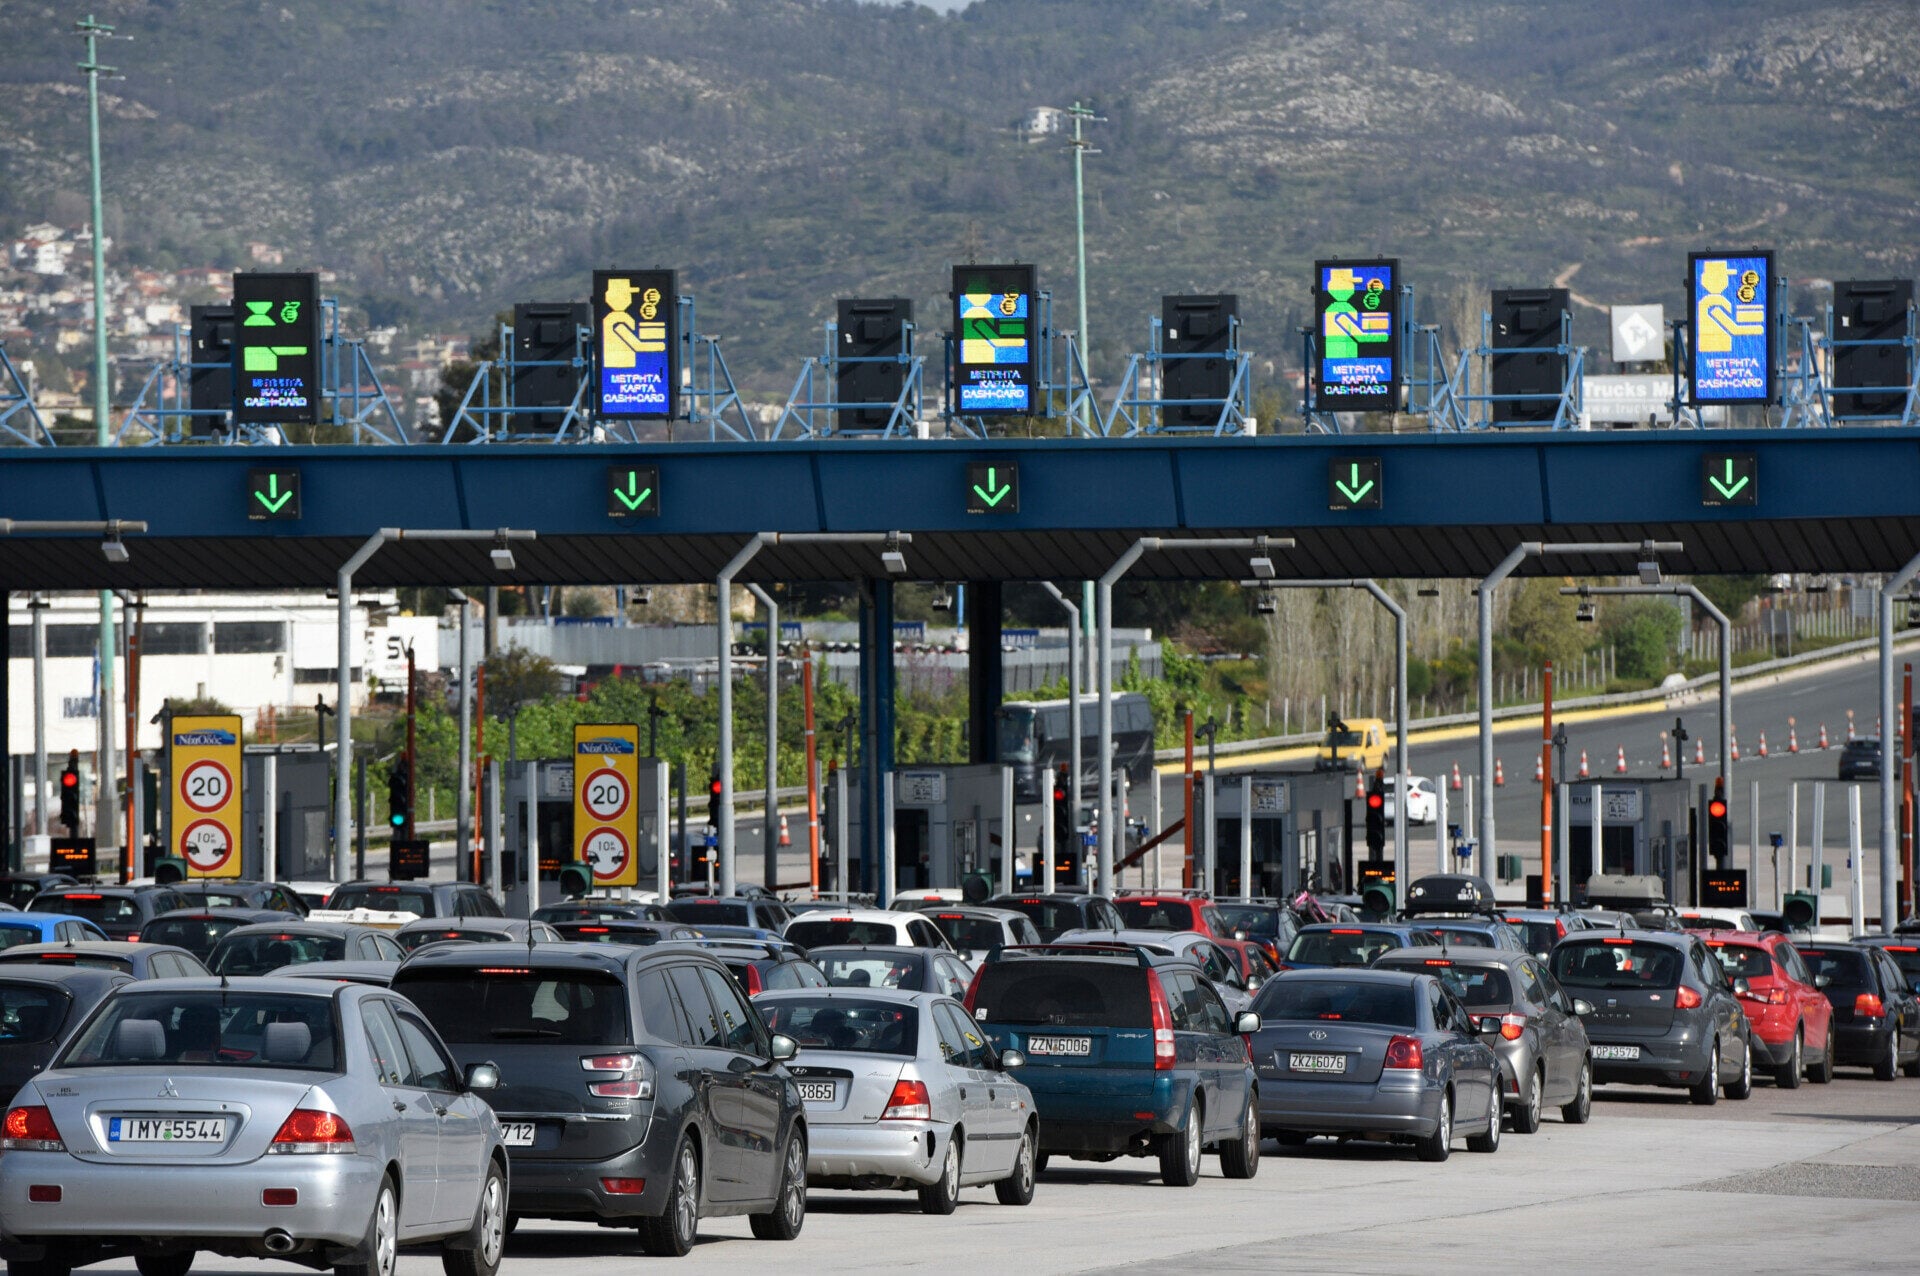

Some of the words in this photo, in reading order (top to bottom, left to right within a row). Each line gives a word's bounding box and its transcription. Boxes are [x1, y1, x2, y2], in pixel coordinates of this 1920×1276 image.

[1585, 382, 1647, 397] Trucks
[192, 777, 221, 796] 20
[592, 785, 619, 804] 20
[197, 832, 211, 843] 10
[598, 841, 610, 851] 10
